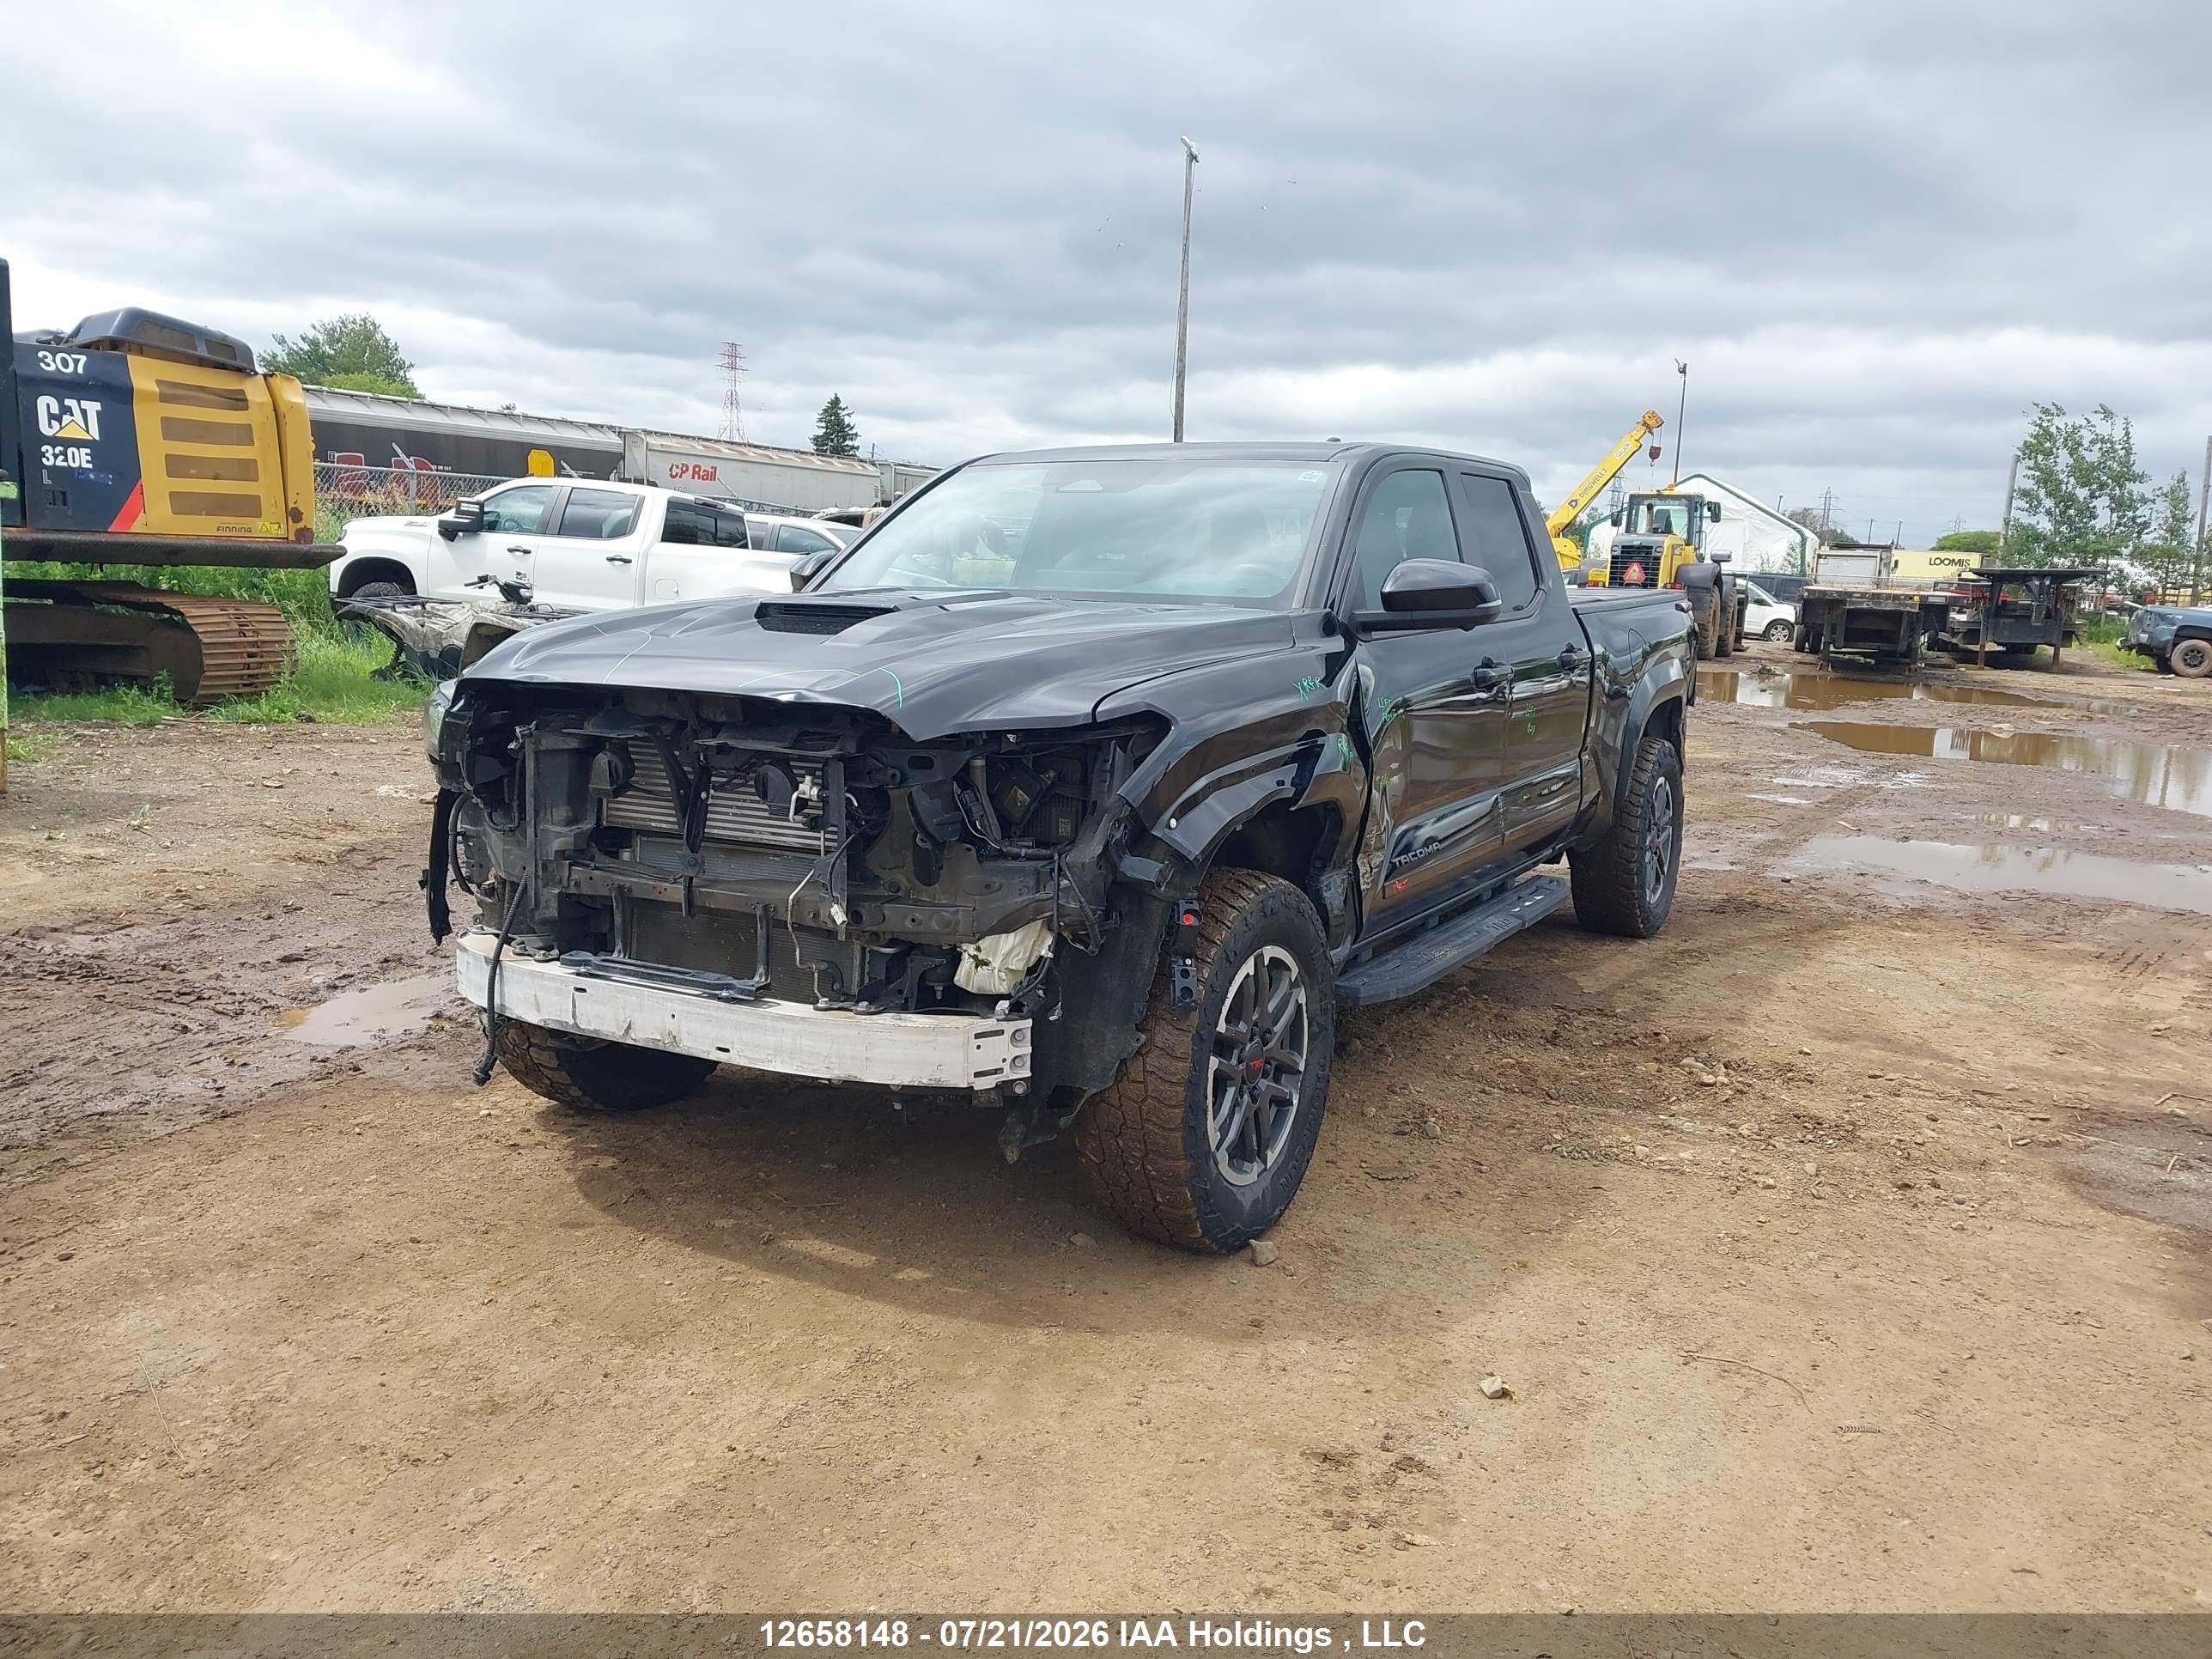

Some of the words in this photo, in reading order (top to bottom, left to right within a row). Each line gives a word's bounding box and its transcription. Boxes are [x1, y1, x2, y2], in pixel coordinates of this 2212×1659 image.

[37, 350, 87, 374] 307
[37, 395, 101, 441] CAT
[41, 445, 93, 469] 320E
[42, 470, 52, 484] L
[669, 463, 689, 479] CP
[691, 465, 717, 482] Rail
[1929, 557, 1971, 568] LOOMIS
[1391, 842, 1442, 867] TACOMA
